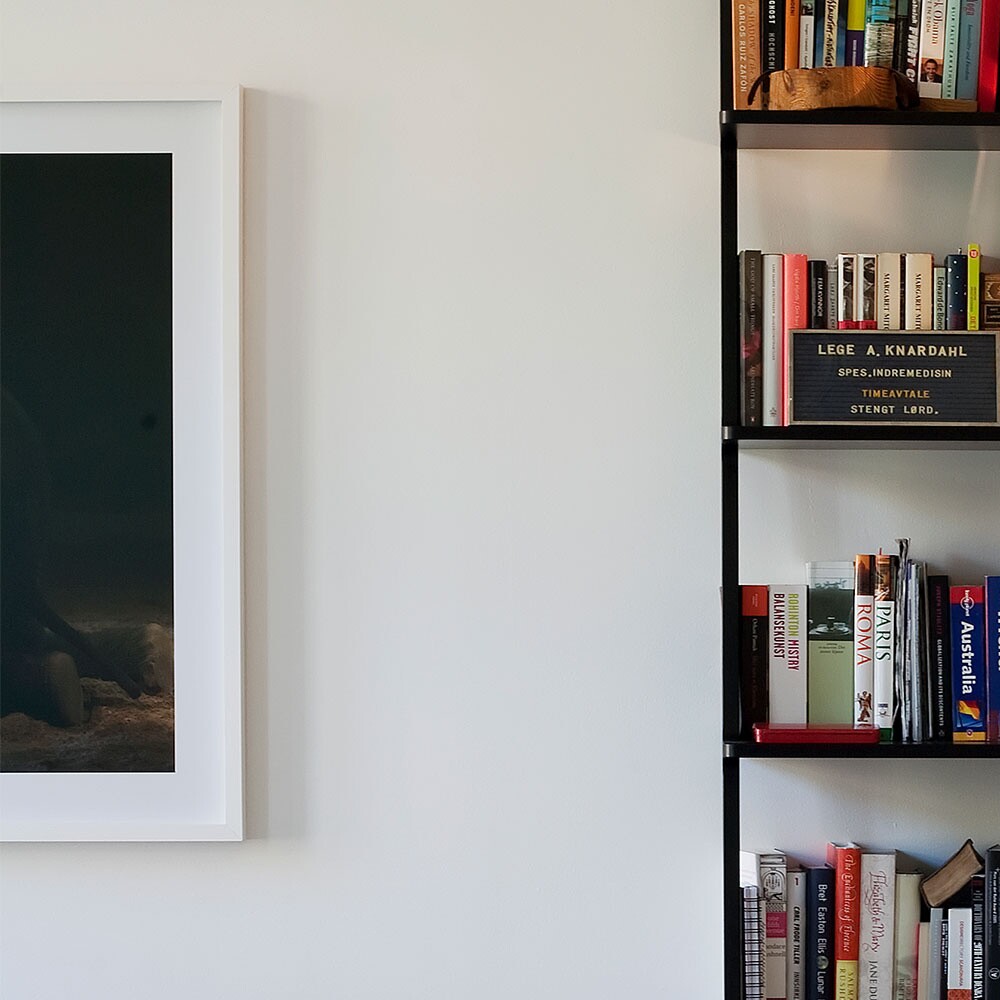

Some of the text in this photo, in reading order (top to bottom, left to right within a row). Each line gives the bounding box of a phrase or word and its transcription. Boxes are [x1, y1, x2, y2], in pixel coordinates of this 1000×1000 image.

[931, 10, 944, 46] Obama
[738, 4, 749, 93] CARLOS RUIZ ZAFÓN
[906, 27, 919, 66] FIGHT
[937, 277, 945, 302] Edward
[818, 344, 968, 357] LEGE A. KNARDAHL
[838, 368, 953, 378] SPES.INDREMEDISIN
[862, 389, 931, 399] TIMEAVTALE
[850, 405, 939, 415] STENGT LØRD.
[774, 593, 785, 659] BALANSEKUNST
[788, 593, 799, 672] ROHINTON MISTRY
[857, 604, 872, 667] ROMA
[876, 606, 891, 661] PARIS
[961, 621, 977, 695] Australia
[817, 884, 828, 901] Bret
[840, 855, 856, 952] The Enchantress of Florence
[866, 871, 889, 916] Elizabeth
[817, 907, 827, 933] Easton
[973, 904, 983, 934] DICTIONARY
[817, 938, 827, 954] Ellis
[863, 924, 884, 953] Mary
[816, 971, 827, 994] Lunar
[868, 961, 879, 984] JANE
